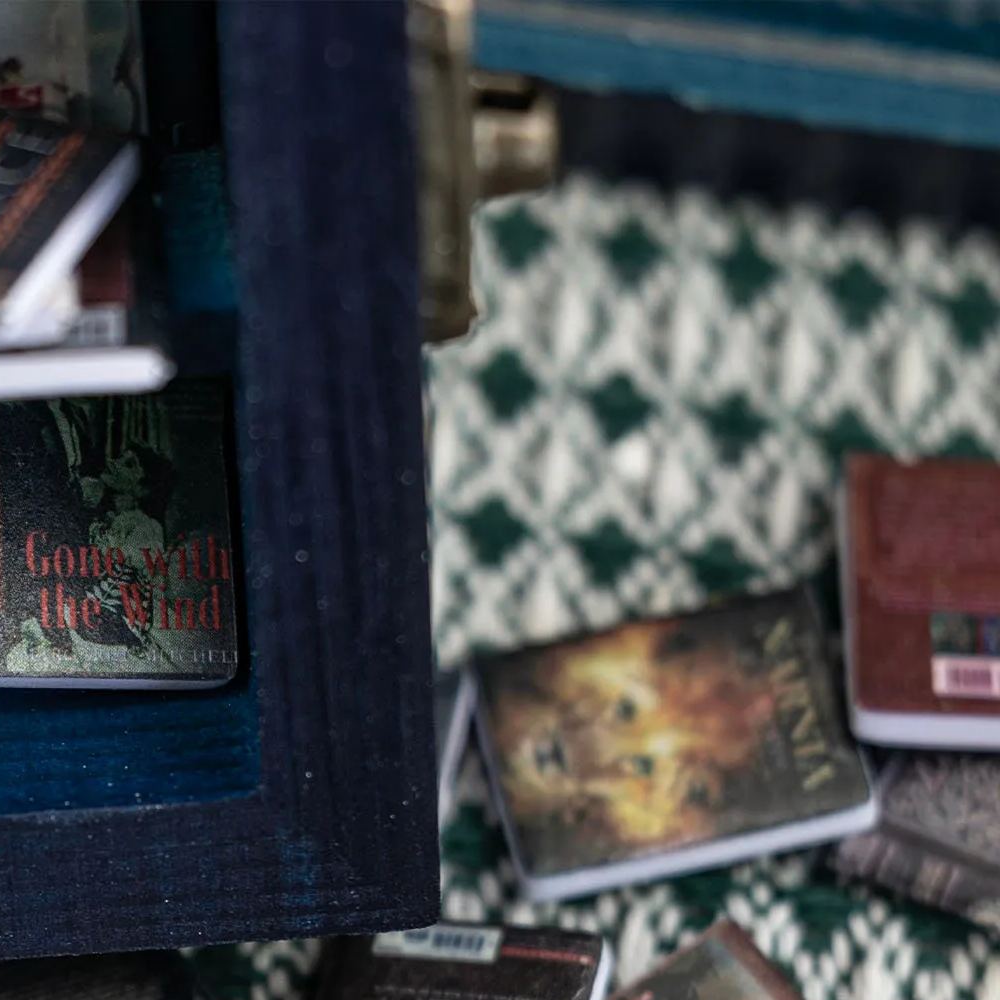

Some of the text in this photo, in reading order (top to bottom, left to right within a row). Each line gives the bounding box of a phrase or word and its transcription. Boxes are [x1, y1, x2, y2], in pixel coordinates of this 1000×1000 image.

[24, 528, 231, 580] Gone with
[39, 581, 222, 631] the Wind
